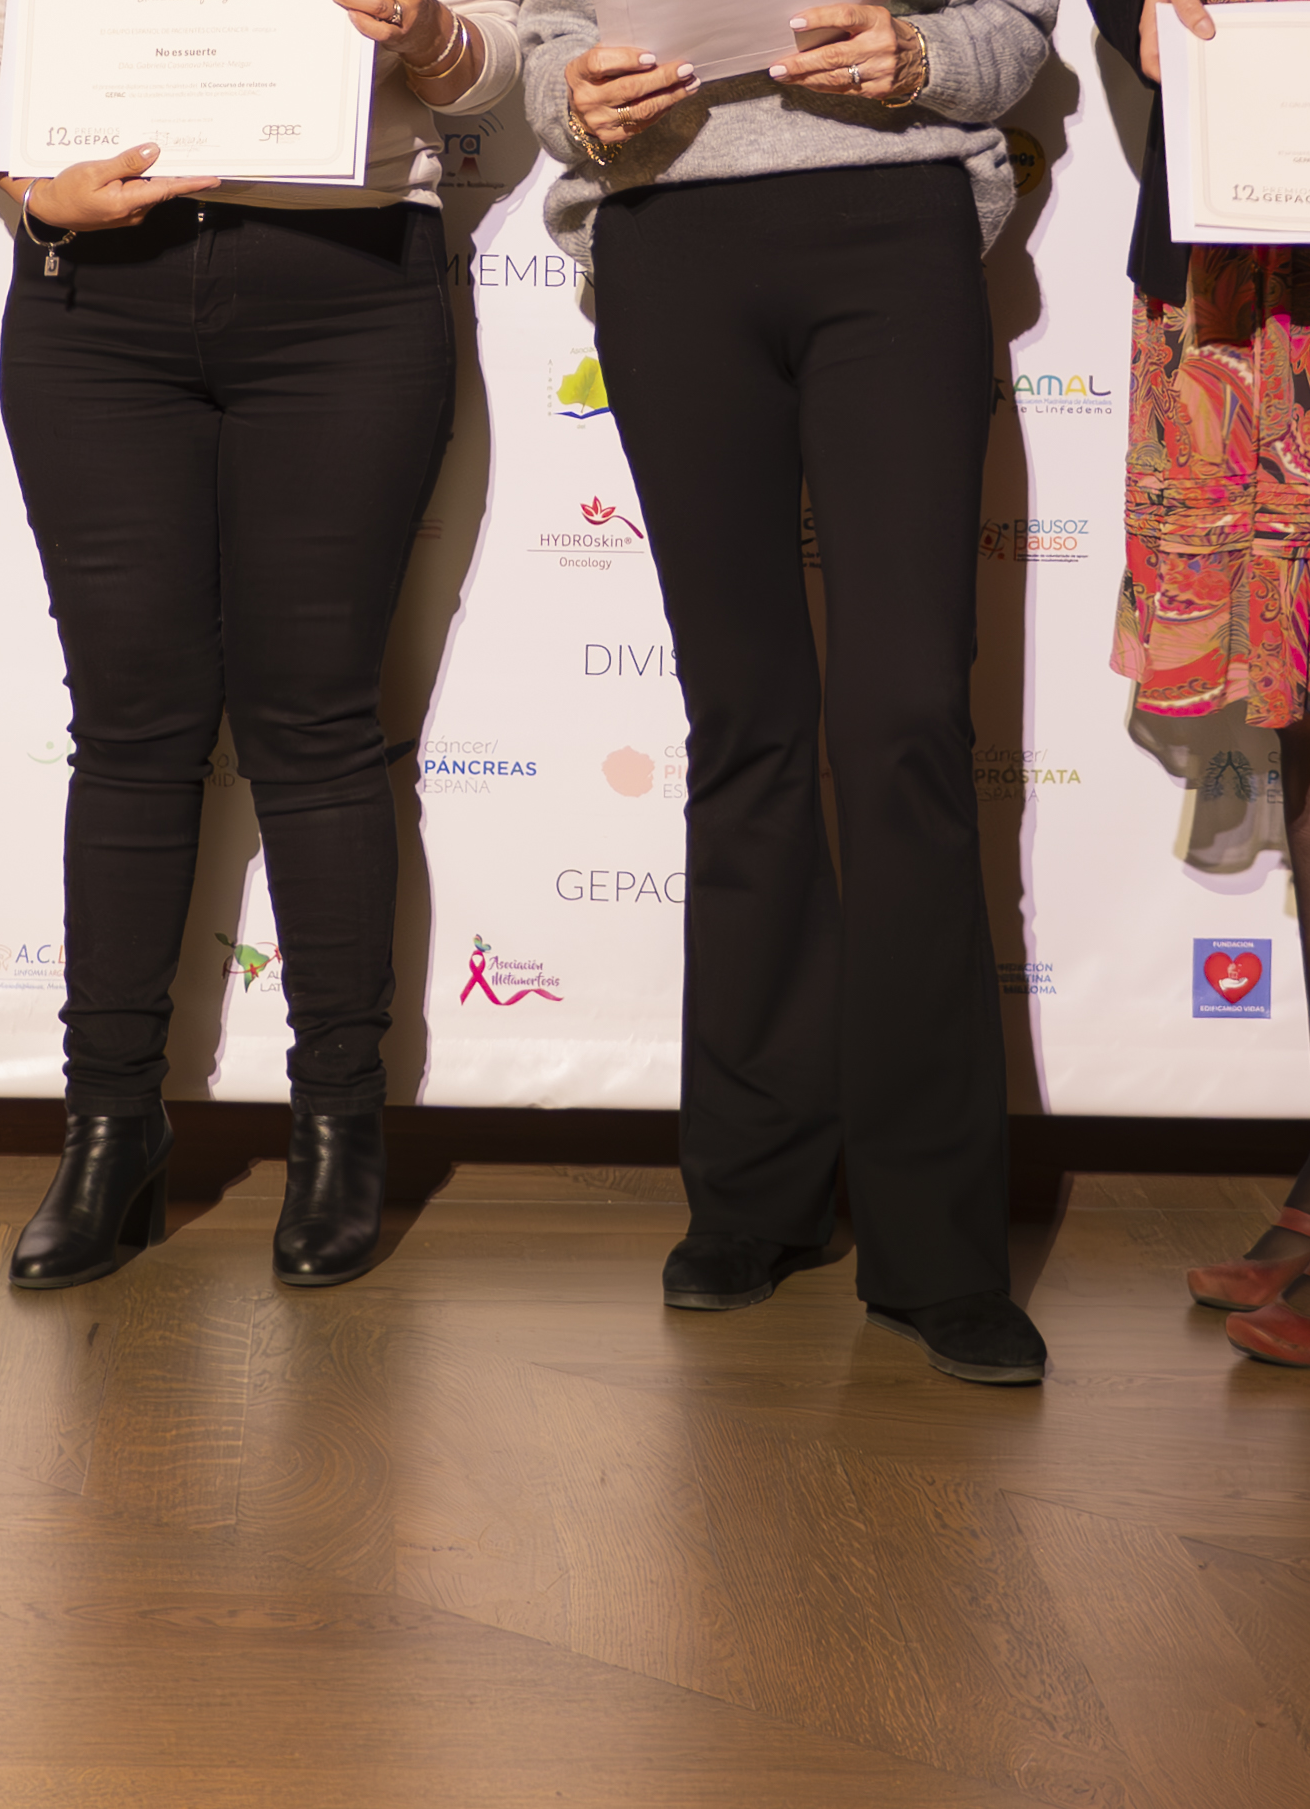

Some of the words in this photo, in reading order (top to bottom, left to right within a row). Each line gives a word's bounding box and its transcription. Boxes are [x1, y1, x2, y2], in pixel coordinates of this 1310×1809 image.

[155, 47, 171, 58] No
[171, 49, 183, 58] es
[184, 47, 217, 57] suerte
[207, 81, 237, 89] Concurso
[46, 126, 71, 147] 12
[73, 135, 120, 146] GEPAC
[1231, 183, 1261, 203] 12
[445, 253, 595, 288] MIEMBR
[1013, 374, 1112, 396] AMAL
[1035, 405, 1113, 415] Linfedema
[1013, 519, 1089, 536] pausoz
[1014, 535, 1078, 556] pauso
[559, 556, 613, 571] Oncology
[423, 755, 538, 778] PÁNCREAS
[974, 764, 1082, 785] PRÓSTATA
[422, 776, 492, 795] ESPAÑA
[15, 943, 67, 965] A.C.L
[488, 955, 544, 971] Asociación
[1243, 1005, 1265, 1014] VIDAS
